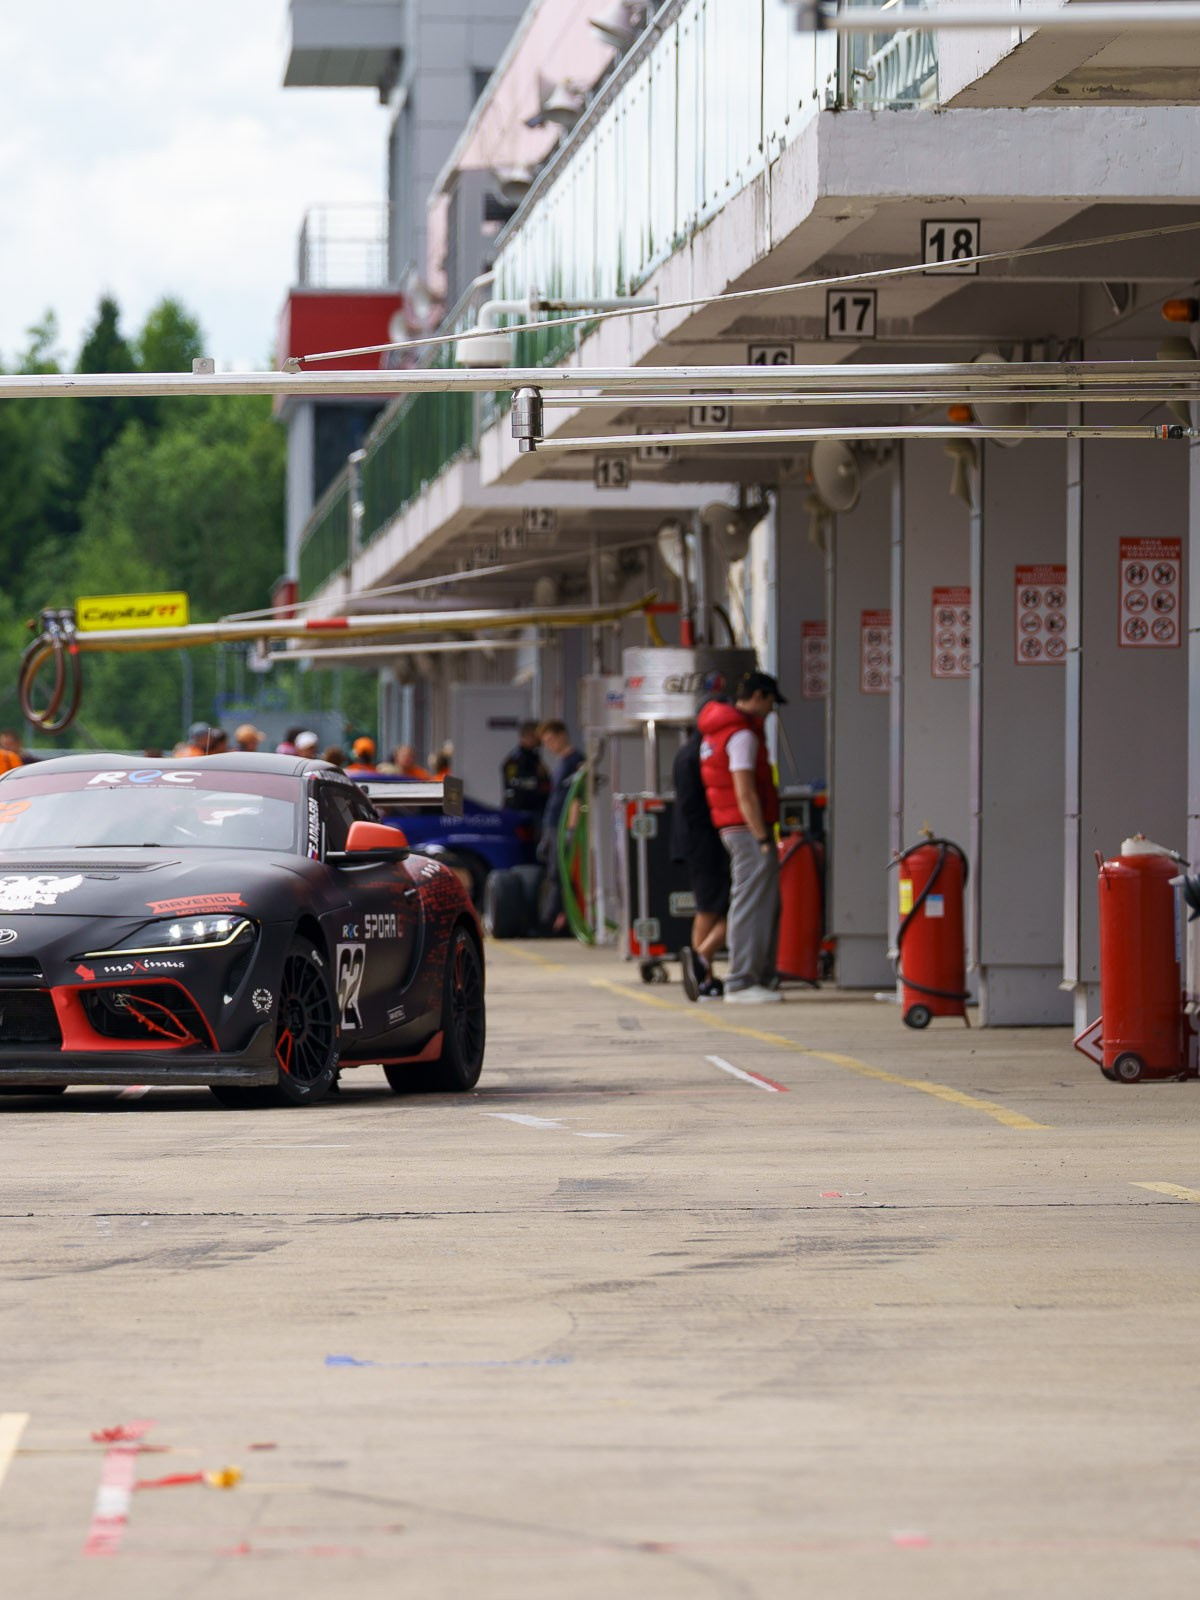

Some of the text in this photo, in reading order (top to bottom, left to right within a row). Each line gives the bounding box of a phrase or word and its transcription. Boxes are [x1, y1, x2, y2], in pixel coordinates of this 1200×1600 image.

[929, 228, 973, 267] 18
[832, 297, 871, 332] 17
[600, 463, 626, 485] 13
[157, 896, 237, 910] RAVENOL
[364, 914, 396, 939] SPORA
